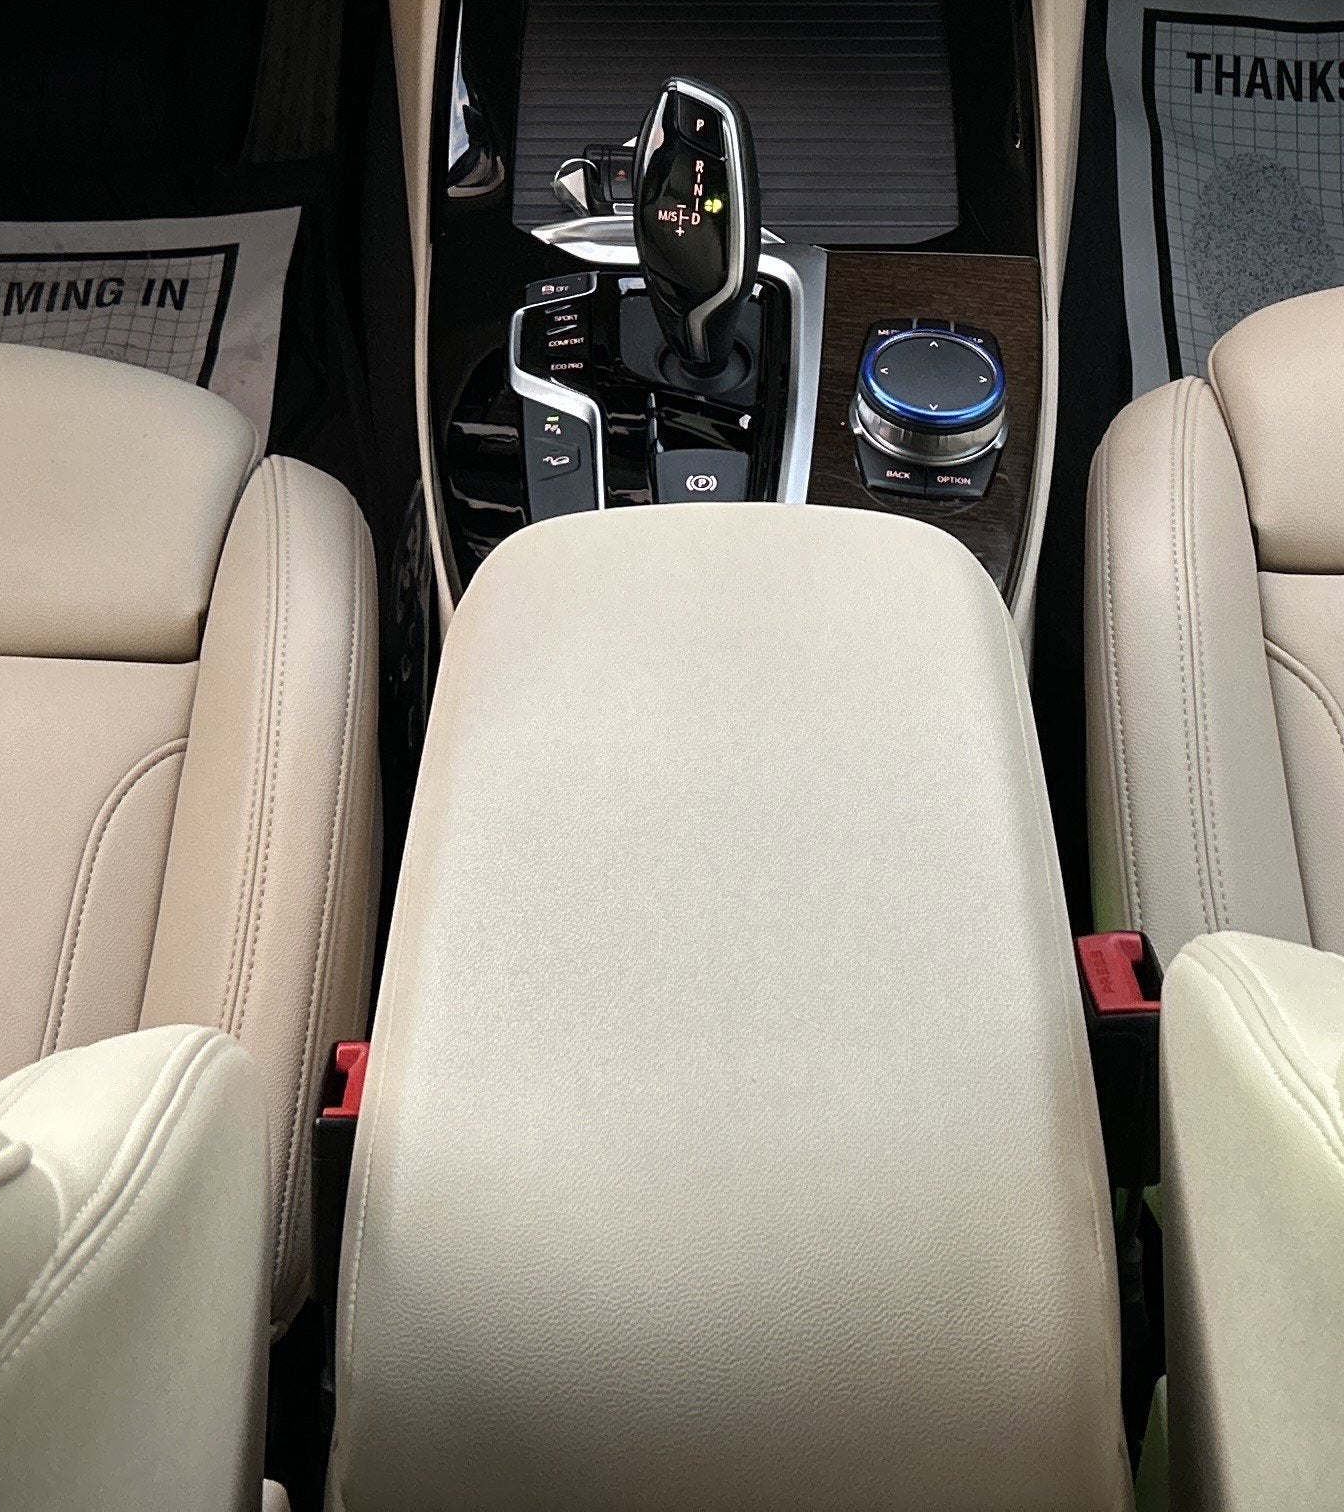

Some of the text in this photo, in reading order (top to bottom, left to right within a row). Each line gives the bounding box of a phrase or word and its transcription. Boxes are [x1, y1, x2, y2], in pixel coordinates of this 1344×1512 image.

[696, 118, 705, 132] P
[695, 159, 705, 173] R
[693, 183, 703, 197] N
[657, 209, 701, 226] M/S D
[141, 278, 190, 311] IN
[554, 314, 578, 322] SPORT
[548, 337, 585, 347] COMFORT
[550, 363, 567, 371] ECO
[886, 469, 911, 479] BACK
[936, 474, 972, 486] OPTION
